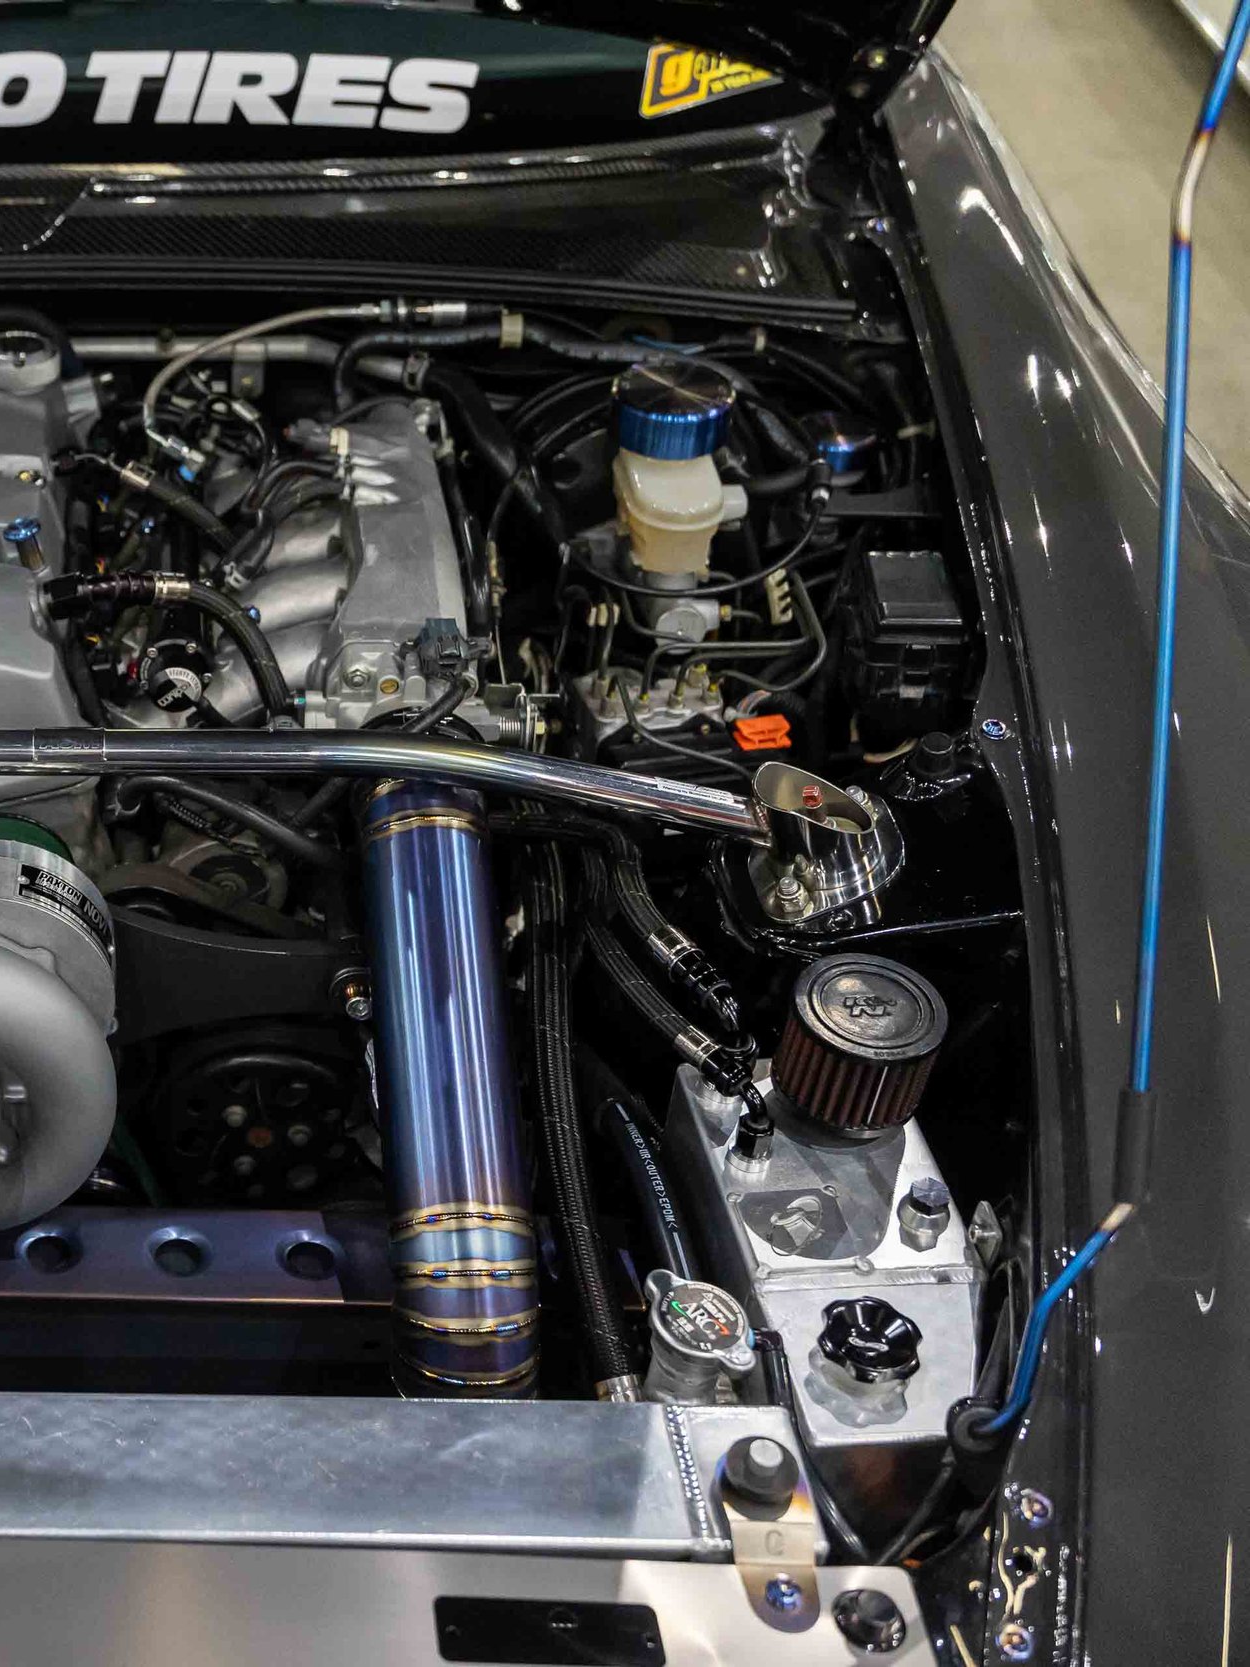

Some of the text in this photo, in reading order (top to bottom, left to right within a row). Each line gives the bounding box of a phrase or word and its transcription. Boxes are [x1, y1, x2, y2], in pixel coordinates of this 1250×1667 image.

[85, 50, 481, 135] TIRES
[39, 872, 82, 902] PAXTON
[679, 1303, 720, 1334] ARC
